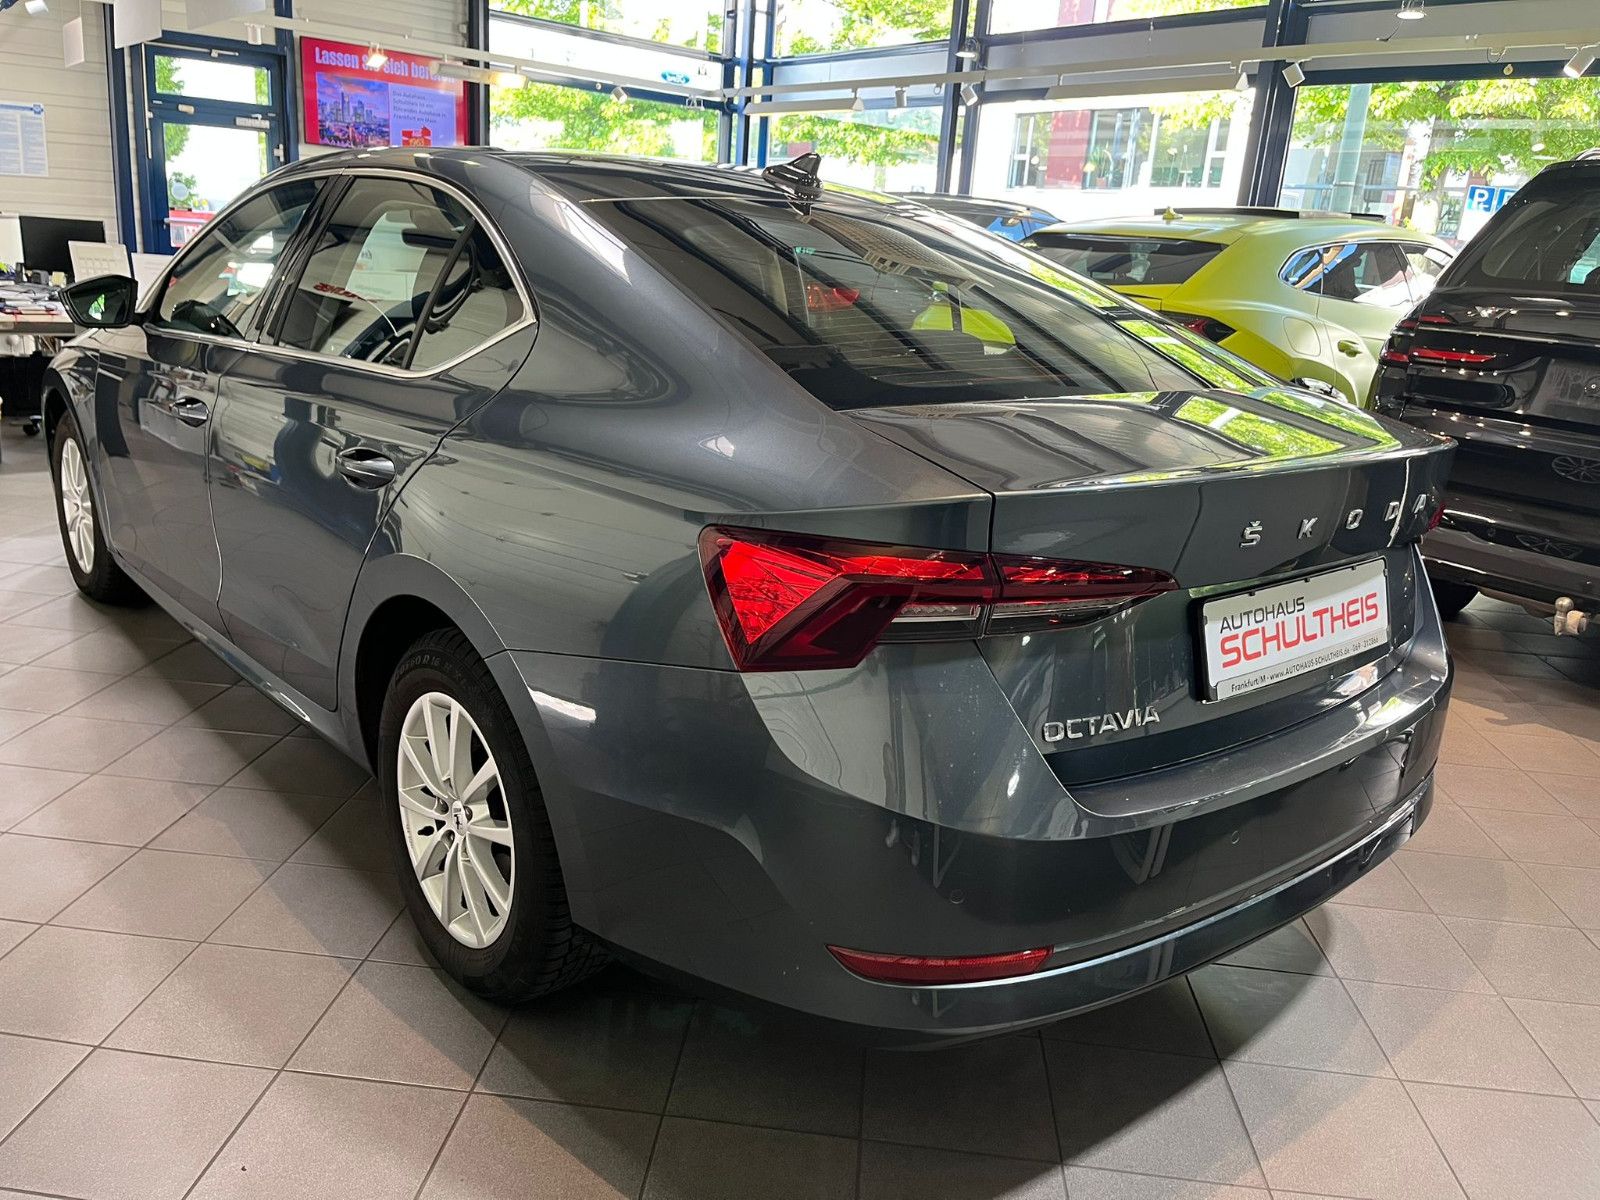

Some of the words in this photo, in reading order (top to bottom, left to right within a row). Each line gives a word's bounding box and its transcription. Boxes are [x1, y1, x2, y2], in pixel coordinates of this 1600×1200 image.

[315, 46, 360, 70] Lassen
[383, 56, 409, 77] sich
[1220, 597, 1305, 634] AUTOHAUS
[1220, 592, 1379, 668] SCHULTHEIS
[1043, 705, 1160, 743] OCTAVIA
